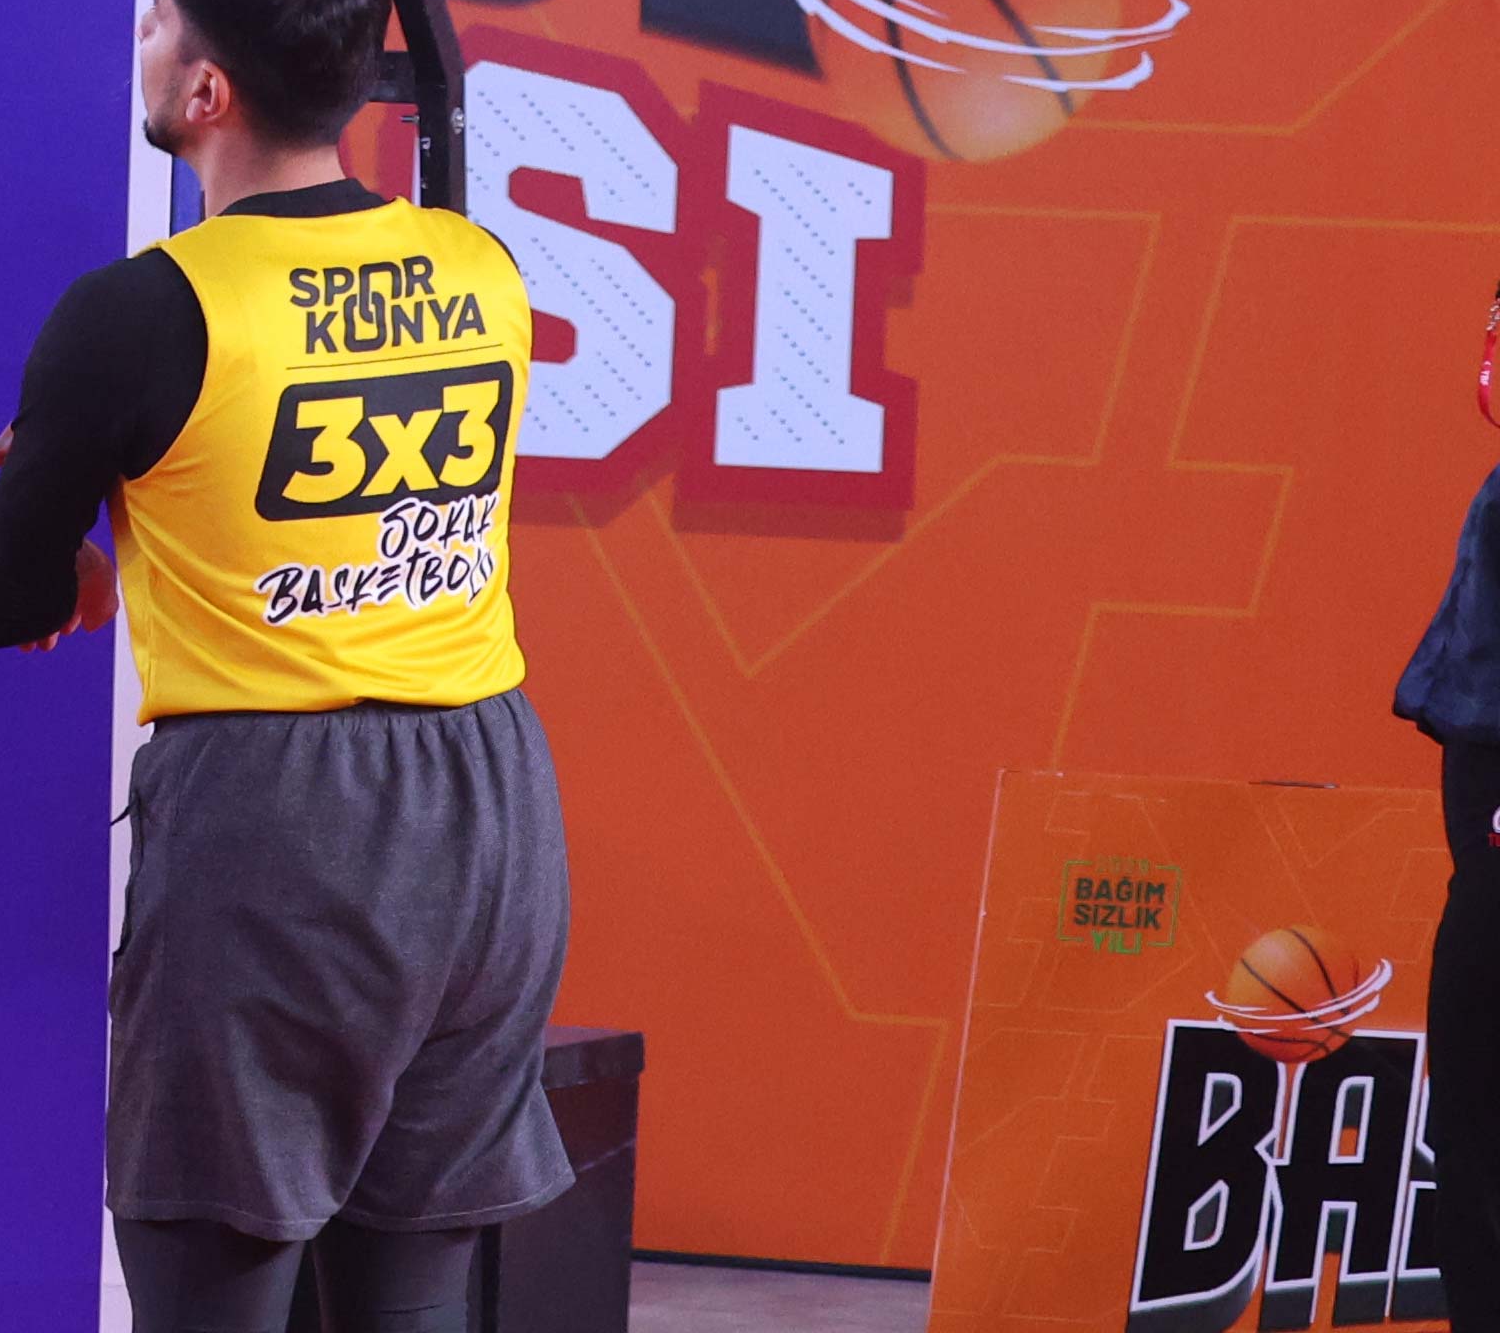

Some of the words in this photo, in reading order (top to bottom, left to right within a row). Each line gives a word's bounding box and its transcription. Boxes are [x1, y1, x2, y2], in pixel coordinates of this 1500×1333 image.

[290, 255, 435, 311] SPOR
[305, 291, 487, 354] KONYA
[379, 493, 500, 561] SOKAK
[1073, 903, 1162, 931] SIZLIK
[1075, 876, 1166, 904] BAĞIM
